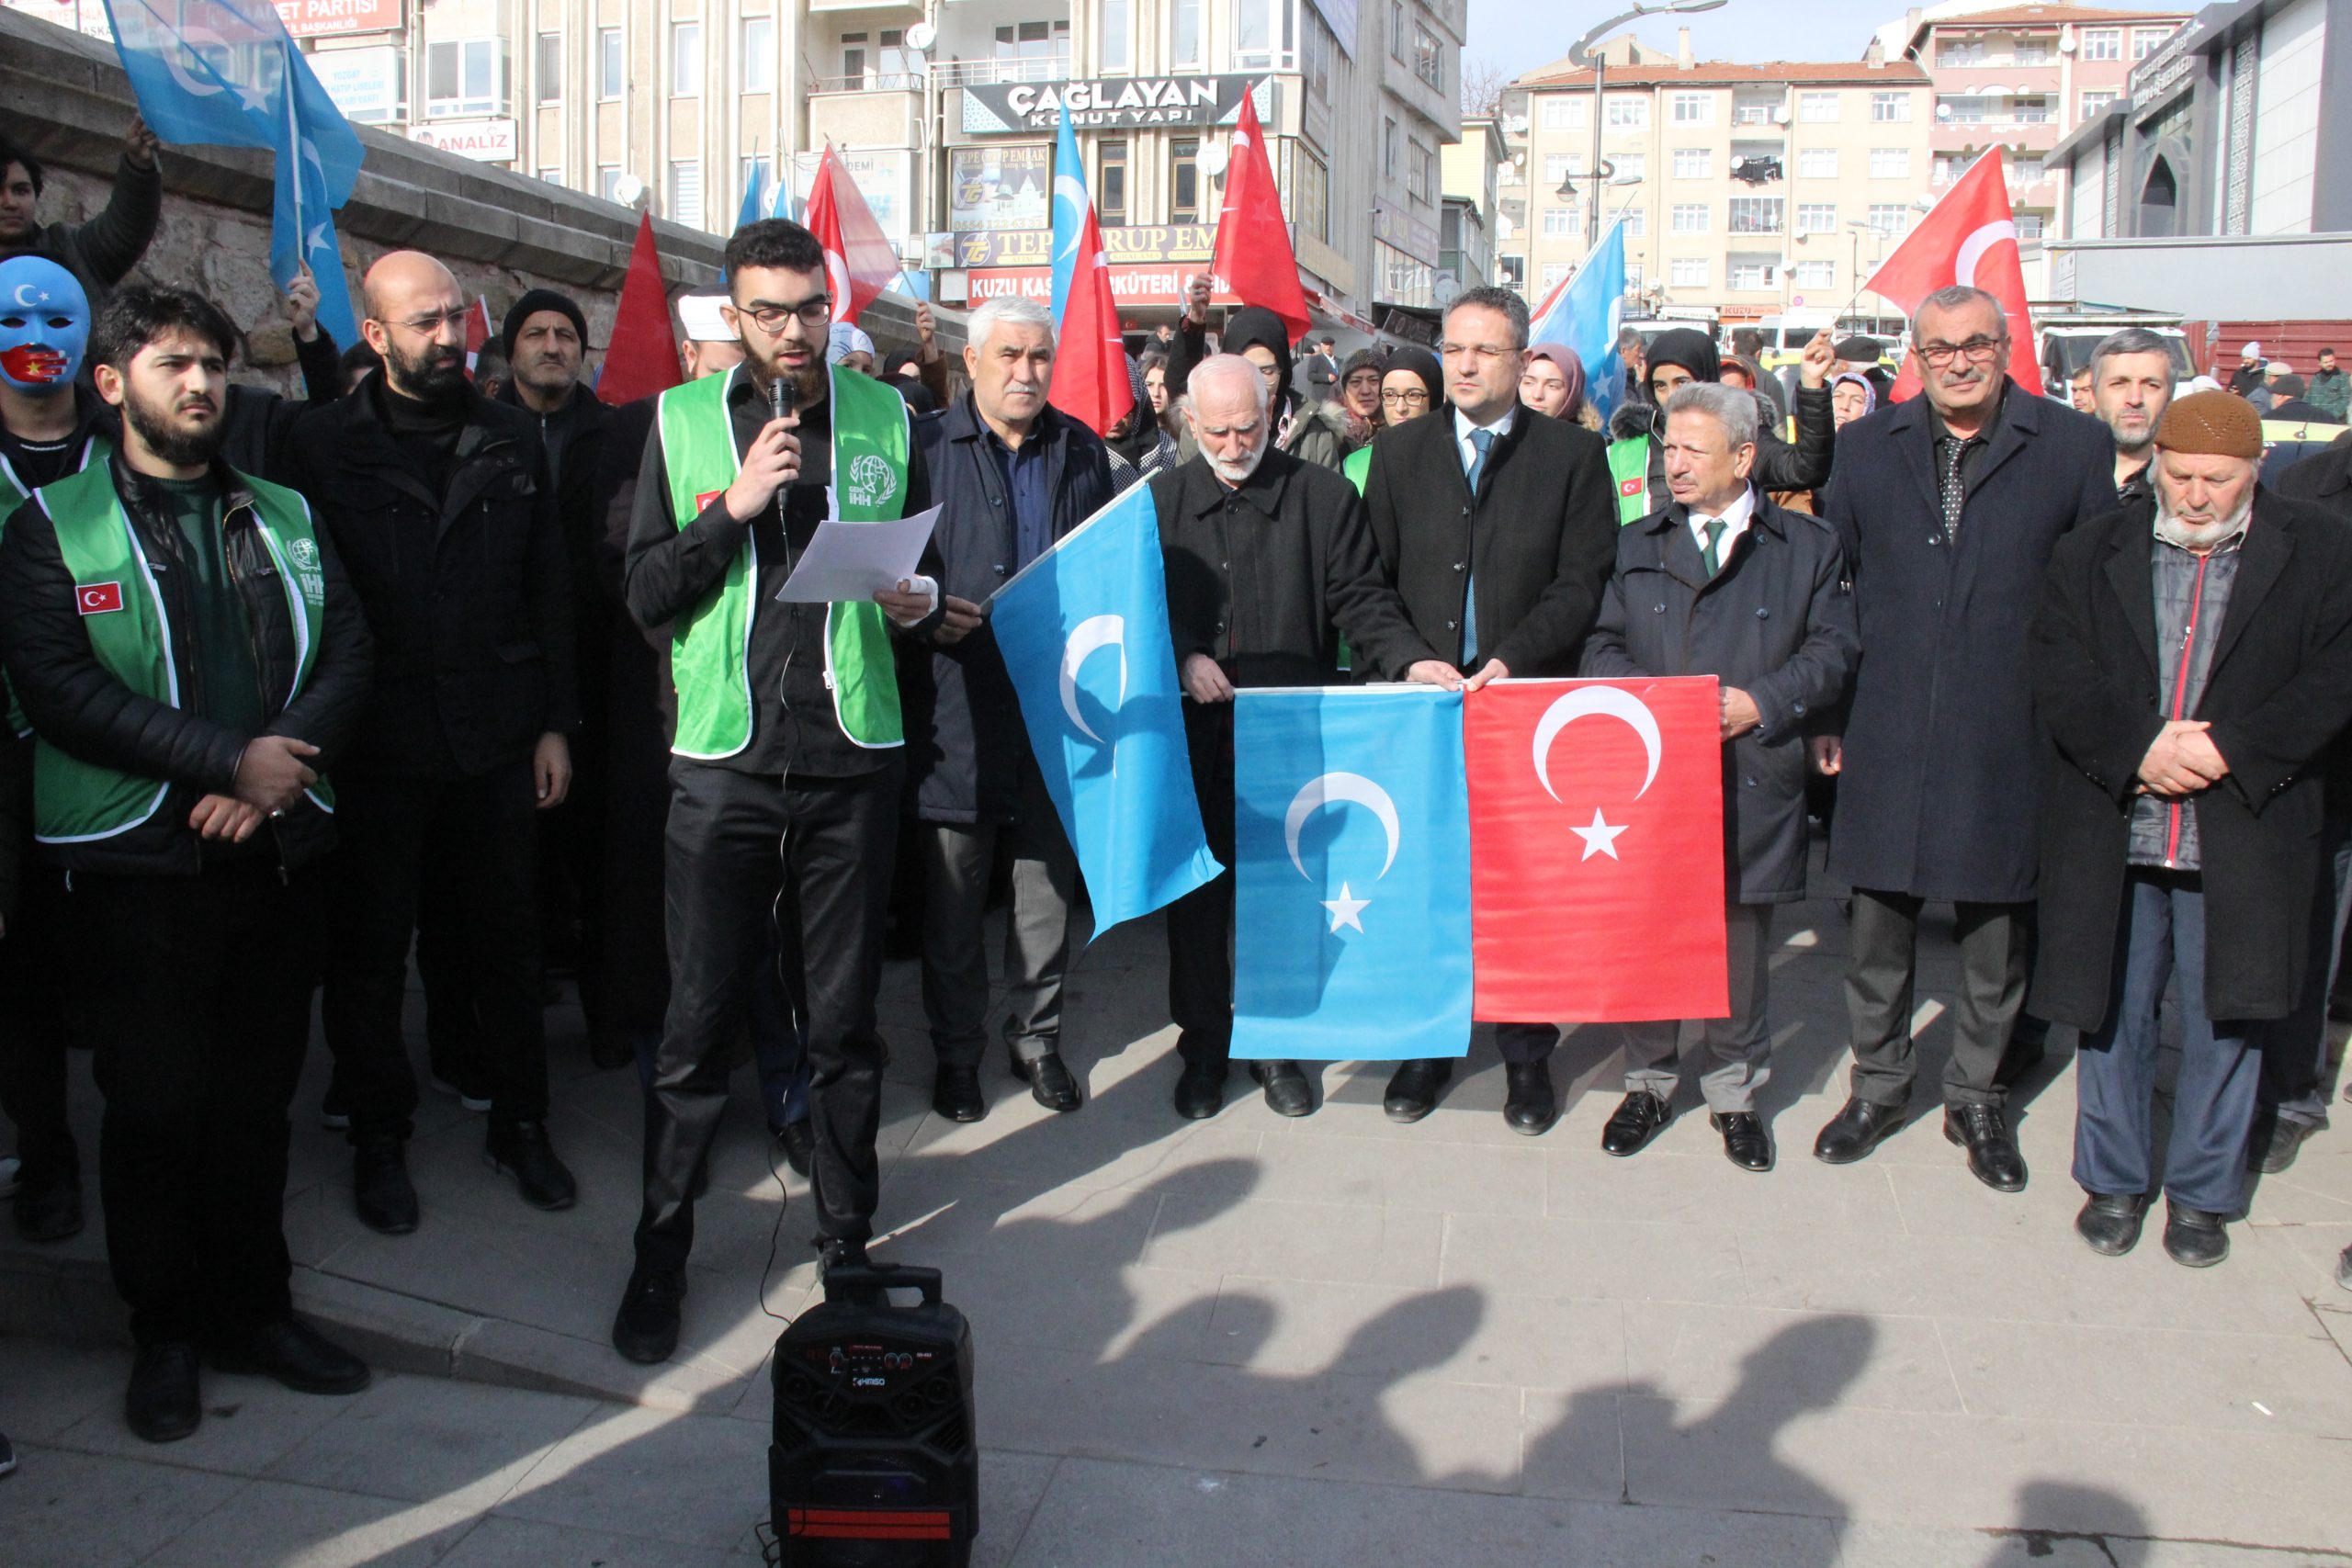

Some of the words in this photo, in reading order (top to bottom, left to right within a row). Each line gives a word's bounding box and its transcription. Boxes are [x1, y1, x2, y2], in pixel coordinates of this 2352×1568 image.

[1008, 79, 1217, 117] ÇAĞLAYAN
[1130, 109, 1192, 124] YAPI
[998, 232, 1053, 255] TEP
[1101, 228, 1168, 252] RUP
[972, 278, 1016, 299] KUZU
